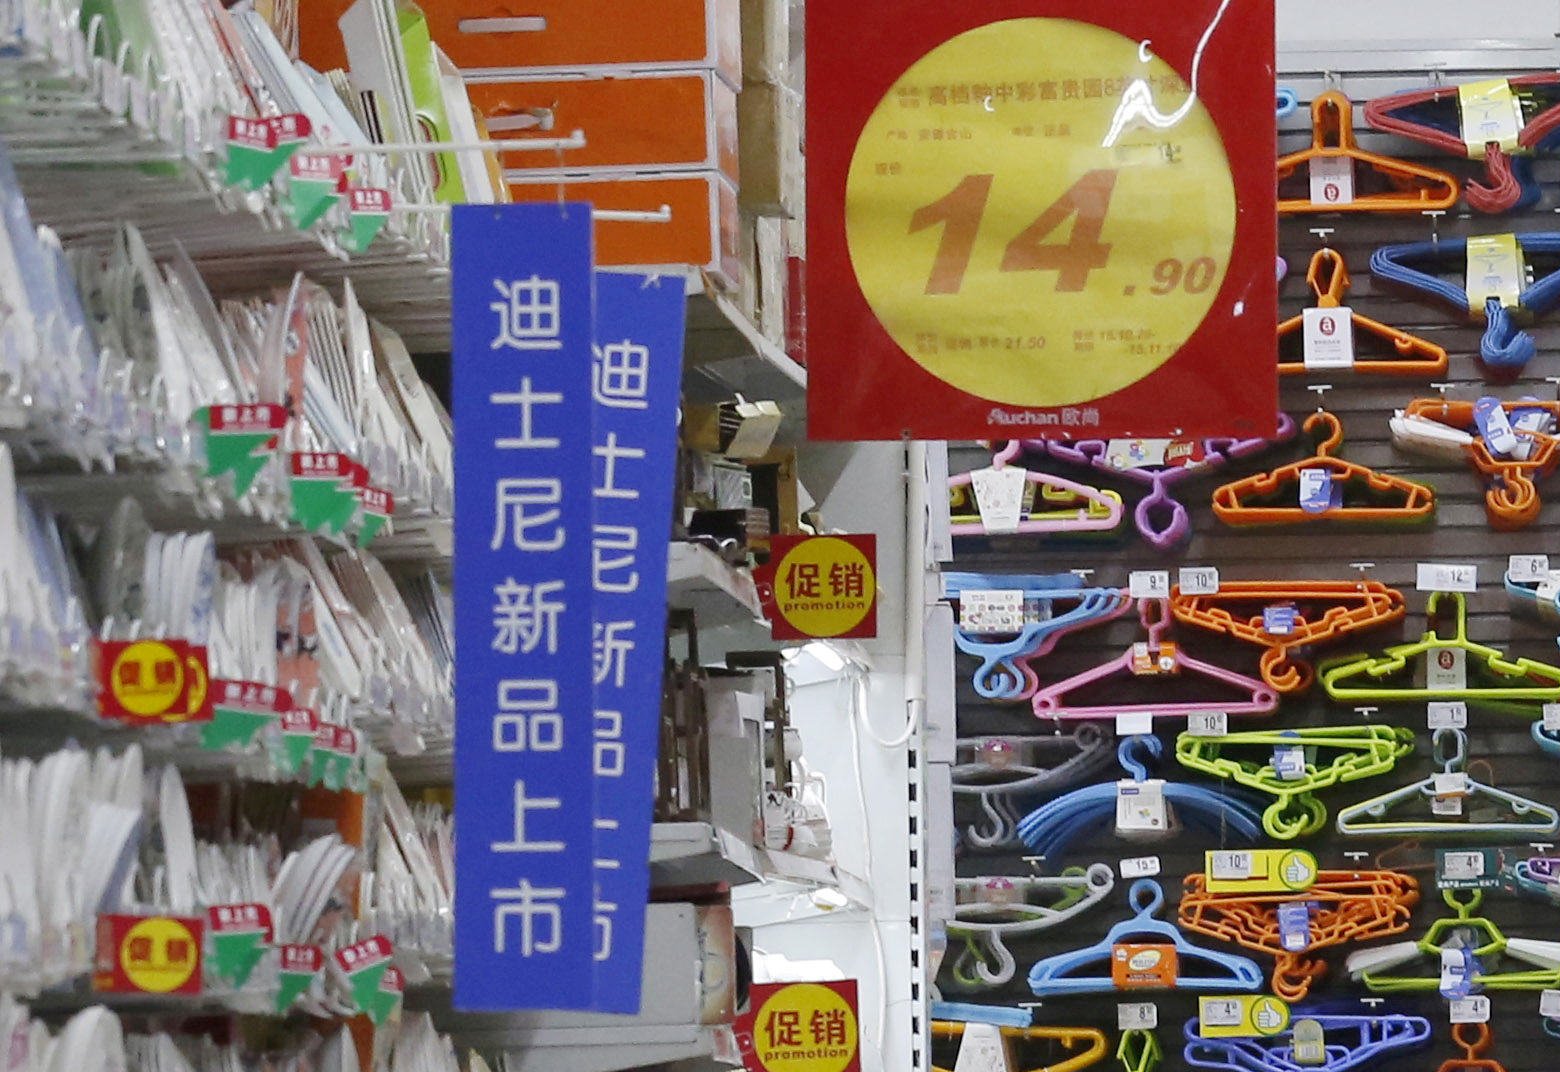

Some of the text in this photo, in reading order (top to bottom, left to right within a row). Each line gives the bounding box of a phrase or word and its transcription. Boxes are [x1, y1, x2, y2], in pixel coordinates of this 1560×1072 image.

[908, 168, 1217, 296] 14.90
[987, 407, 1059, 426] Auchan
[784, 559, 866, 600] 促销
[488, 275, 568, 961] 迪士尼新品上市
[783, 600, 867, 613] promotion
[764, 1005, 848, 1047] 促销
[762, 1048, 849, 1062] promotion
